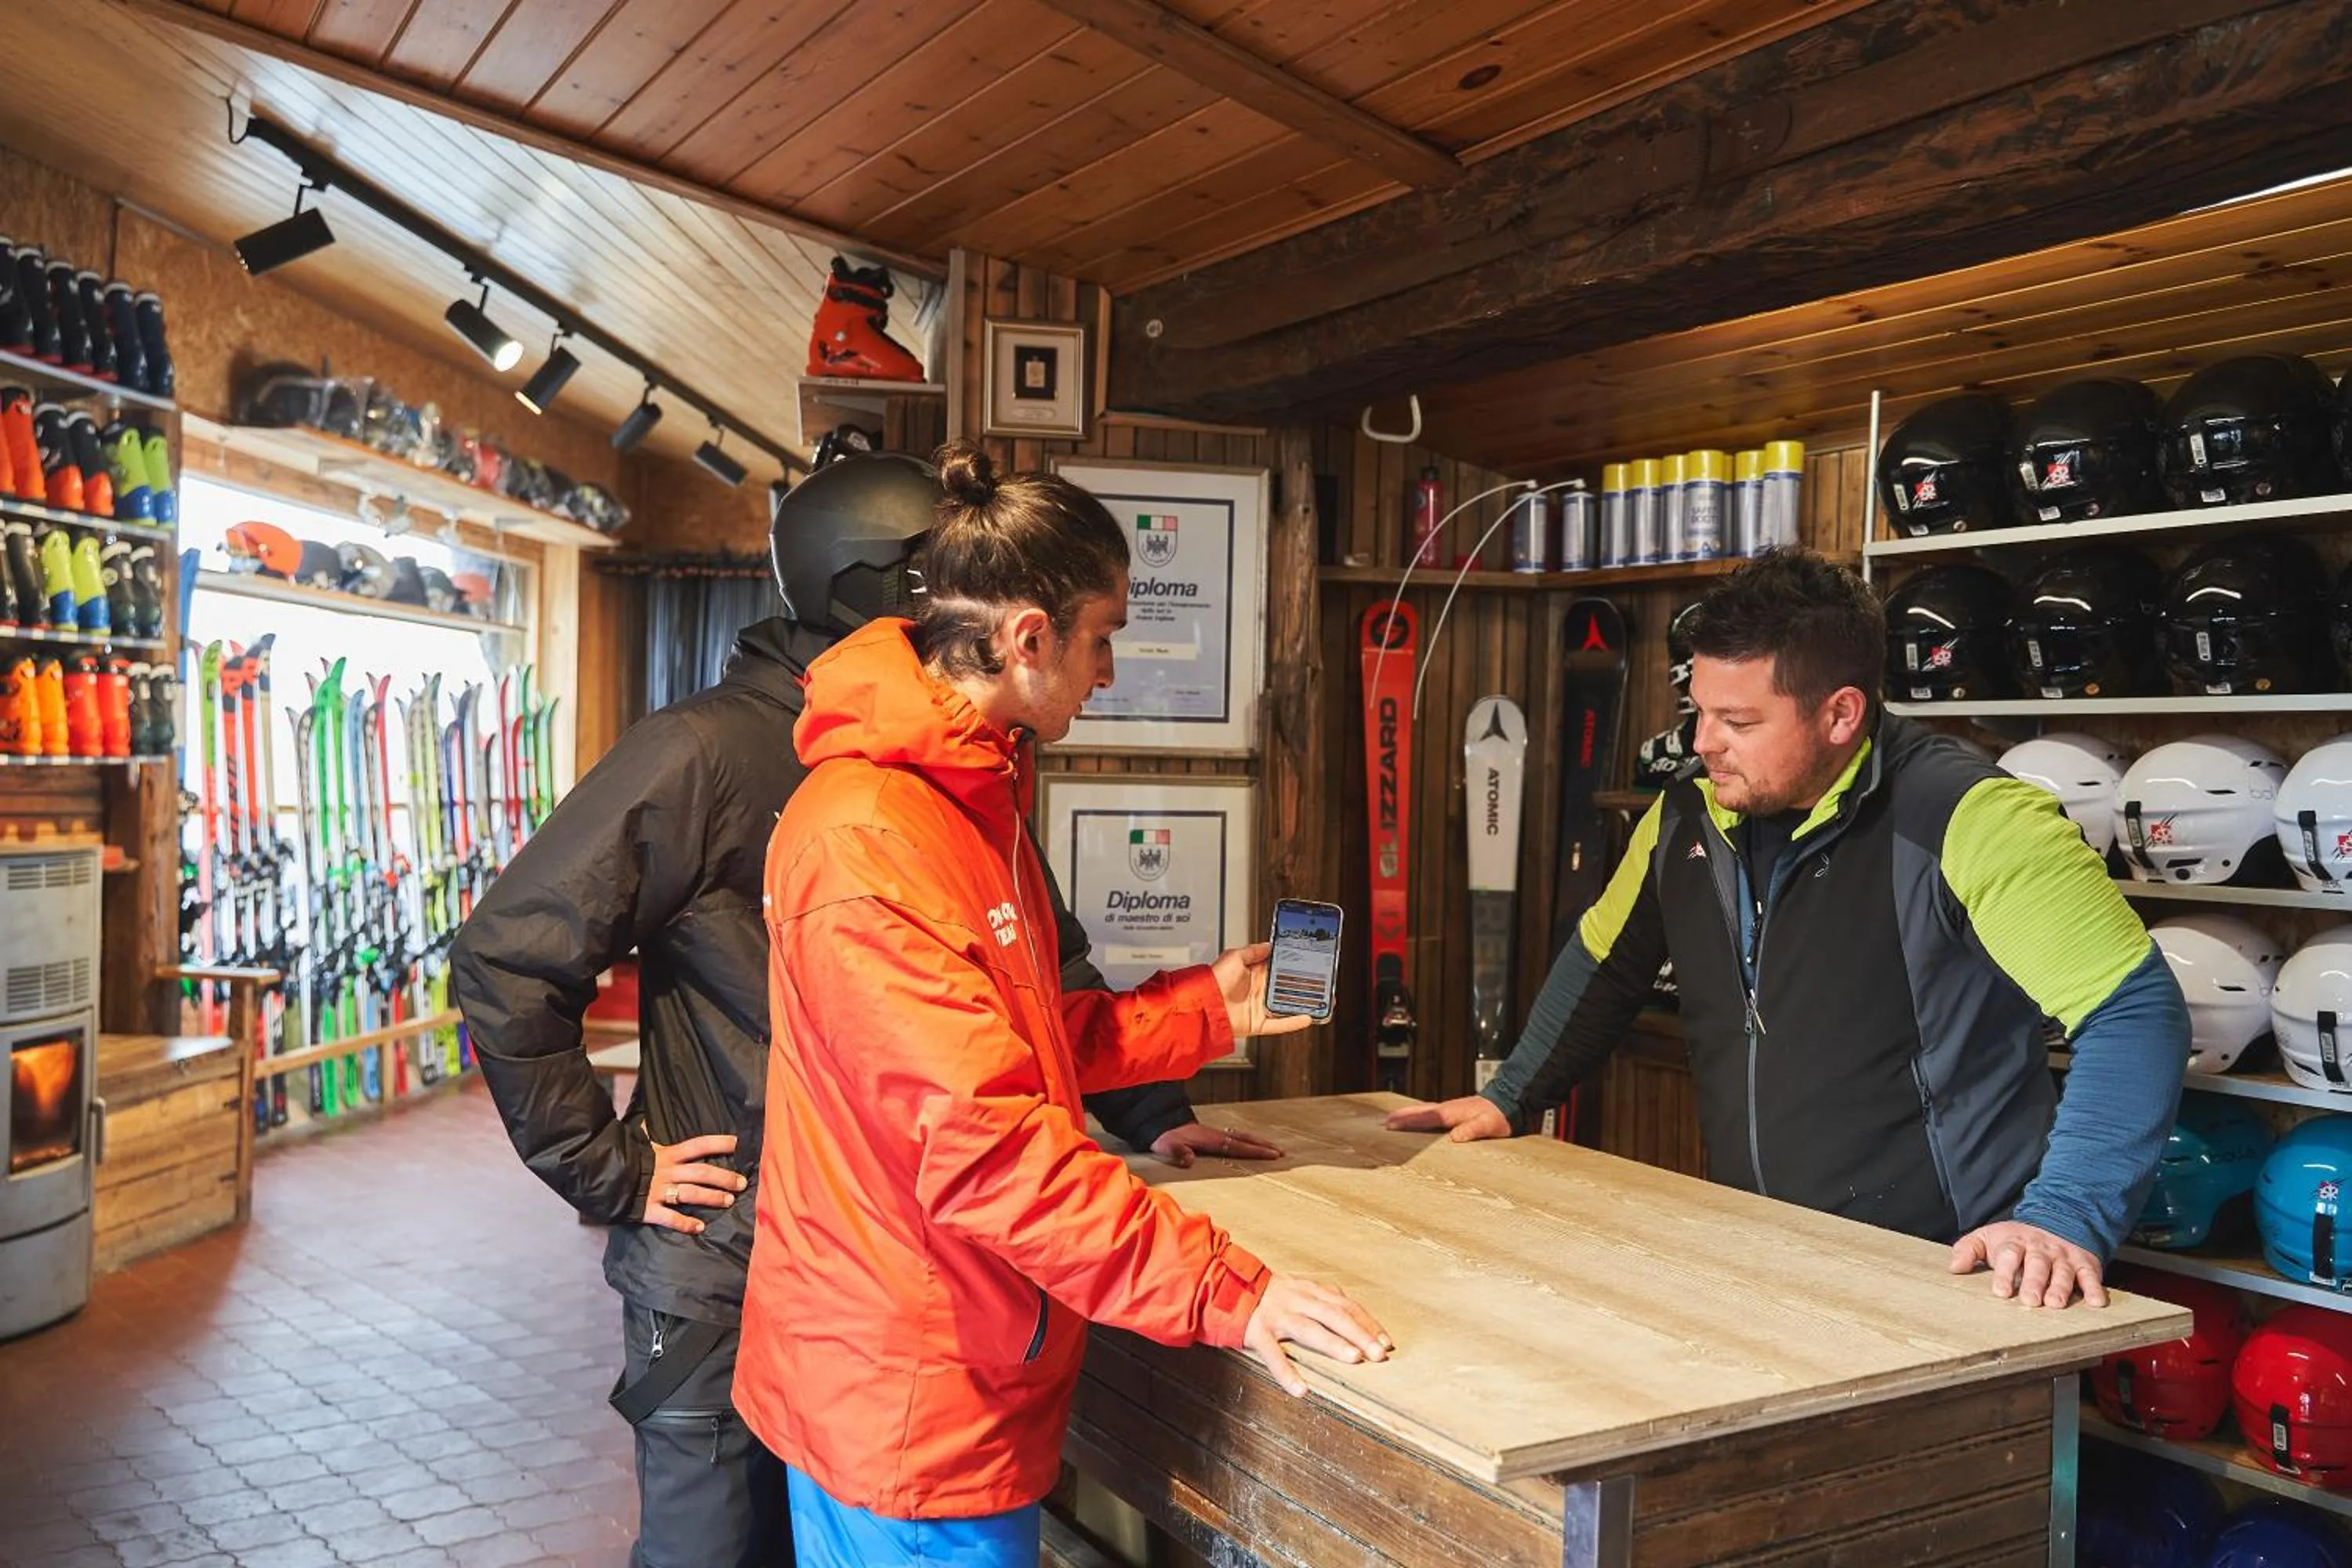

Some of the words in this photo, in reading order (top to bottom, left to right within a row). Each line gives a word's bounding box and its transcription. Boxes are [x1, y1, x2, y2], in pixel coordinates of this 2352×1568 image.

[1129, 576, 1198, 598] iploma
[1379, 697, 1399, 878] BLIZZARD
[1486, 768, 1500, 836] ATOMIC
[1106, 891, 1191, 913] Diploma
[1105, 913, 1115, 923] di
[1117, 914, 1160, 923] maestro
[1163, 913, 1174, 923] di
[1176, 913, 1191, 923] sci
